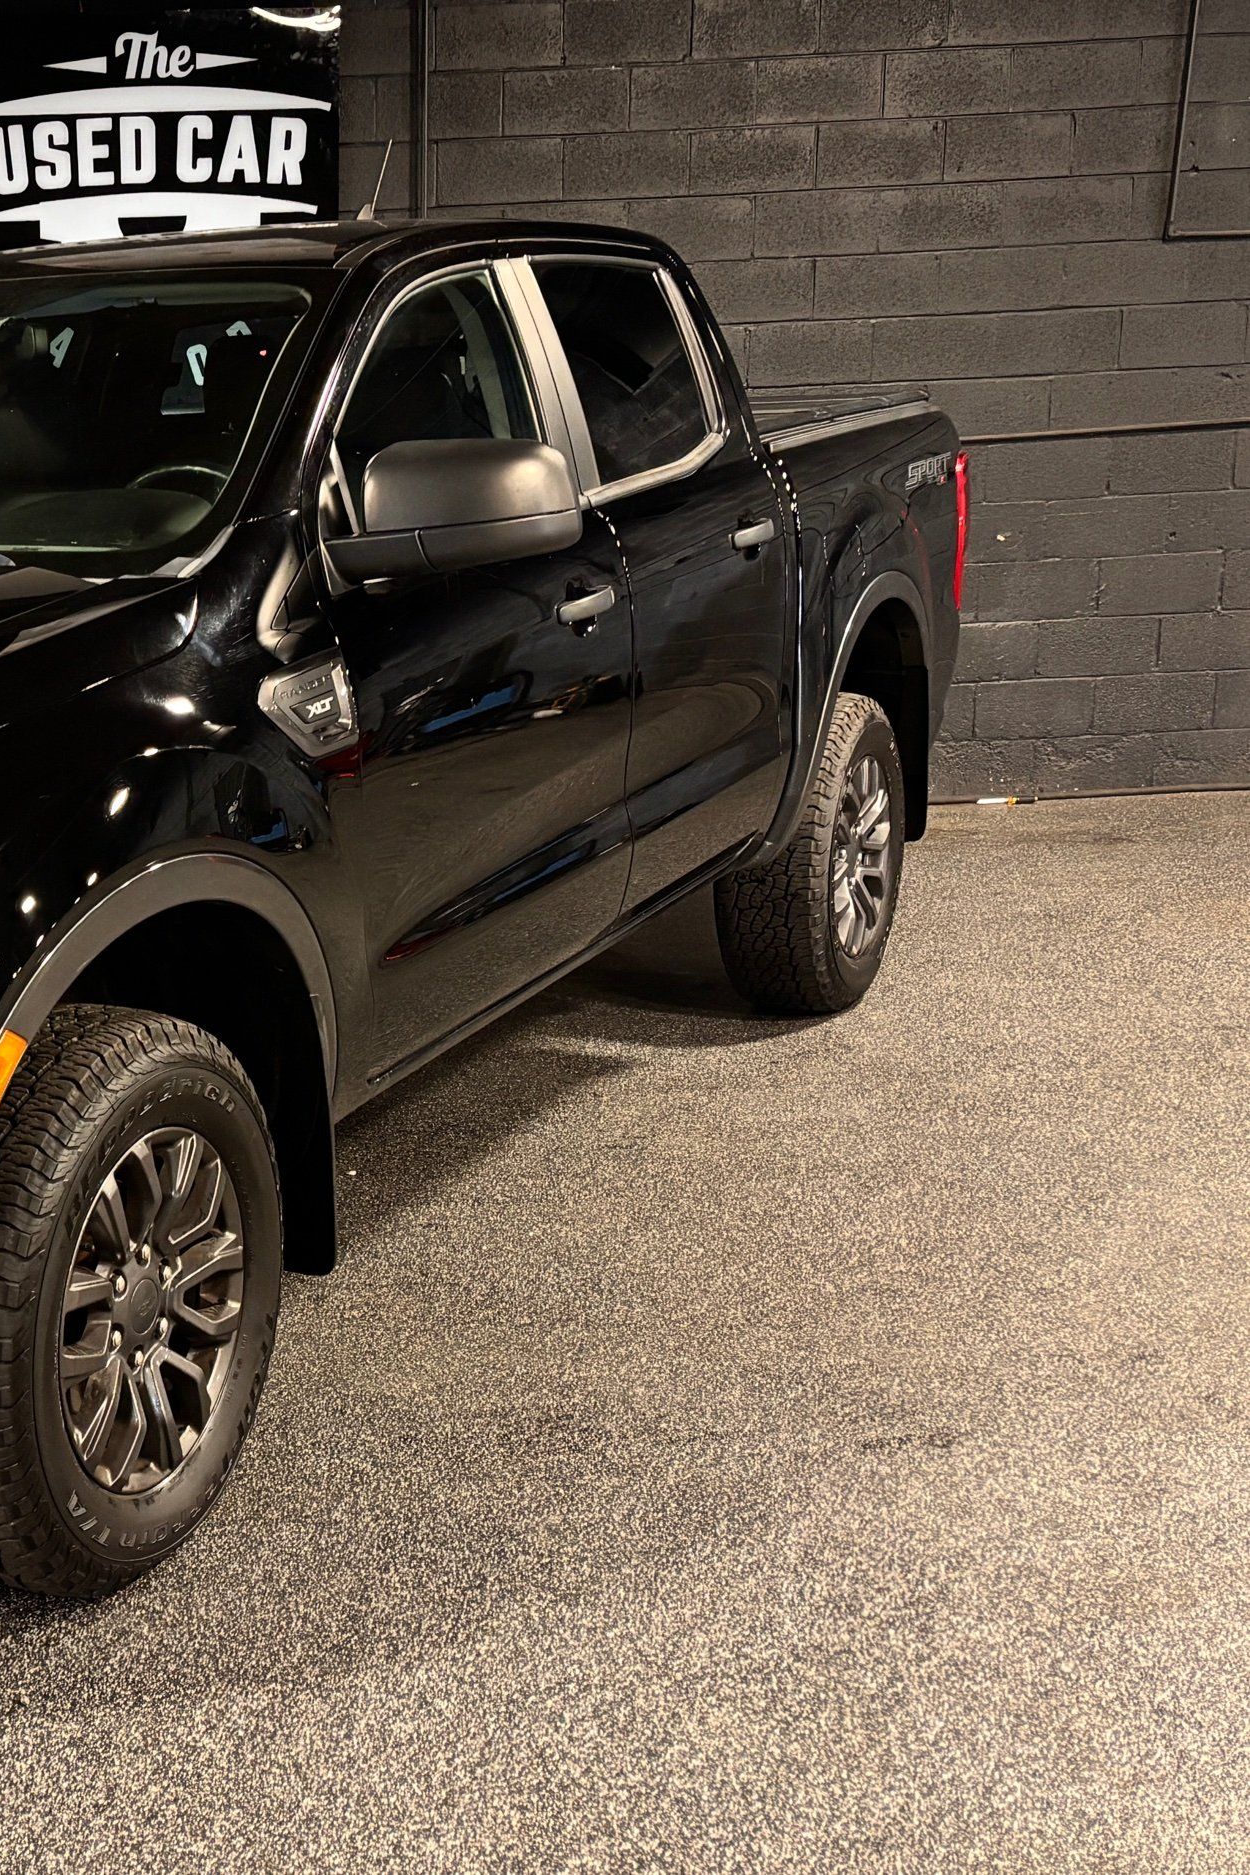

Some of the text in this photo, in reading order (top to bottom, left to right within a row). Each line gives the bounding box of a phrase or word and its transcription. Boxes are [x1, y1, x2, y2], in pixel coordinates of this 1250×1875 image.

[114, 30, 195, 80] The
[176, 115, 308, 186] CAR
[905, 451, 952, 490] SPORT
[306, 696, 334, 719] XLT
